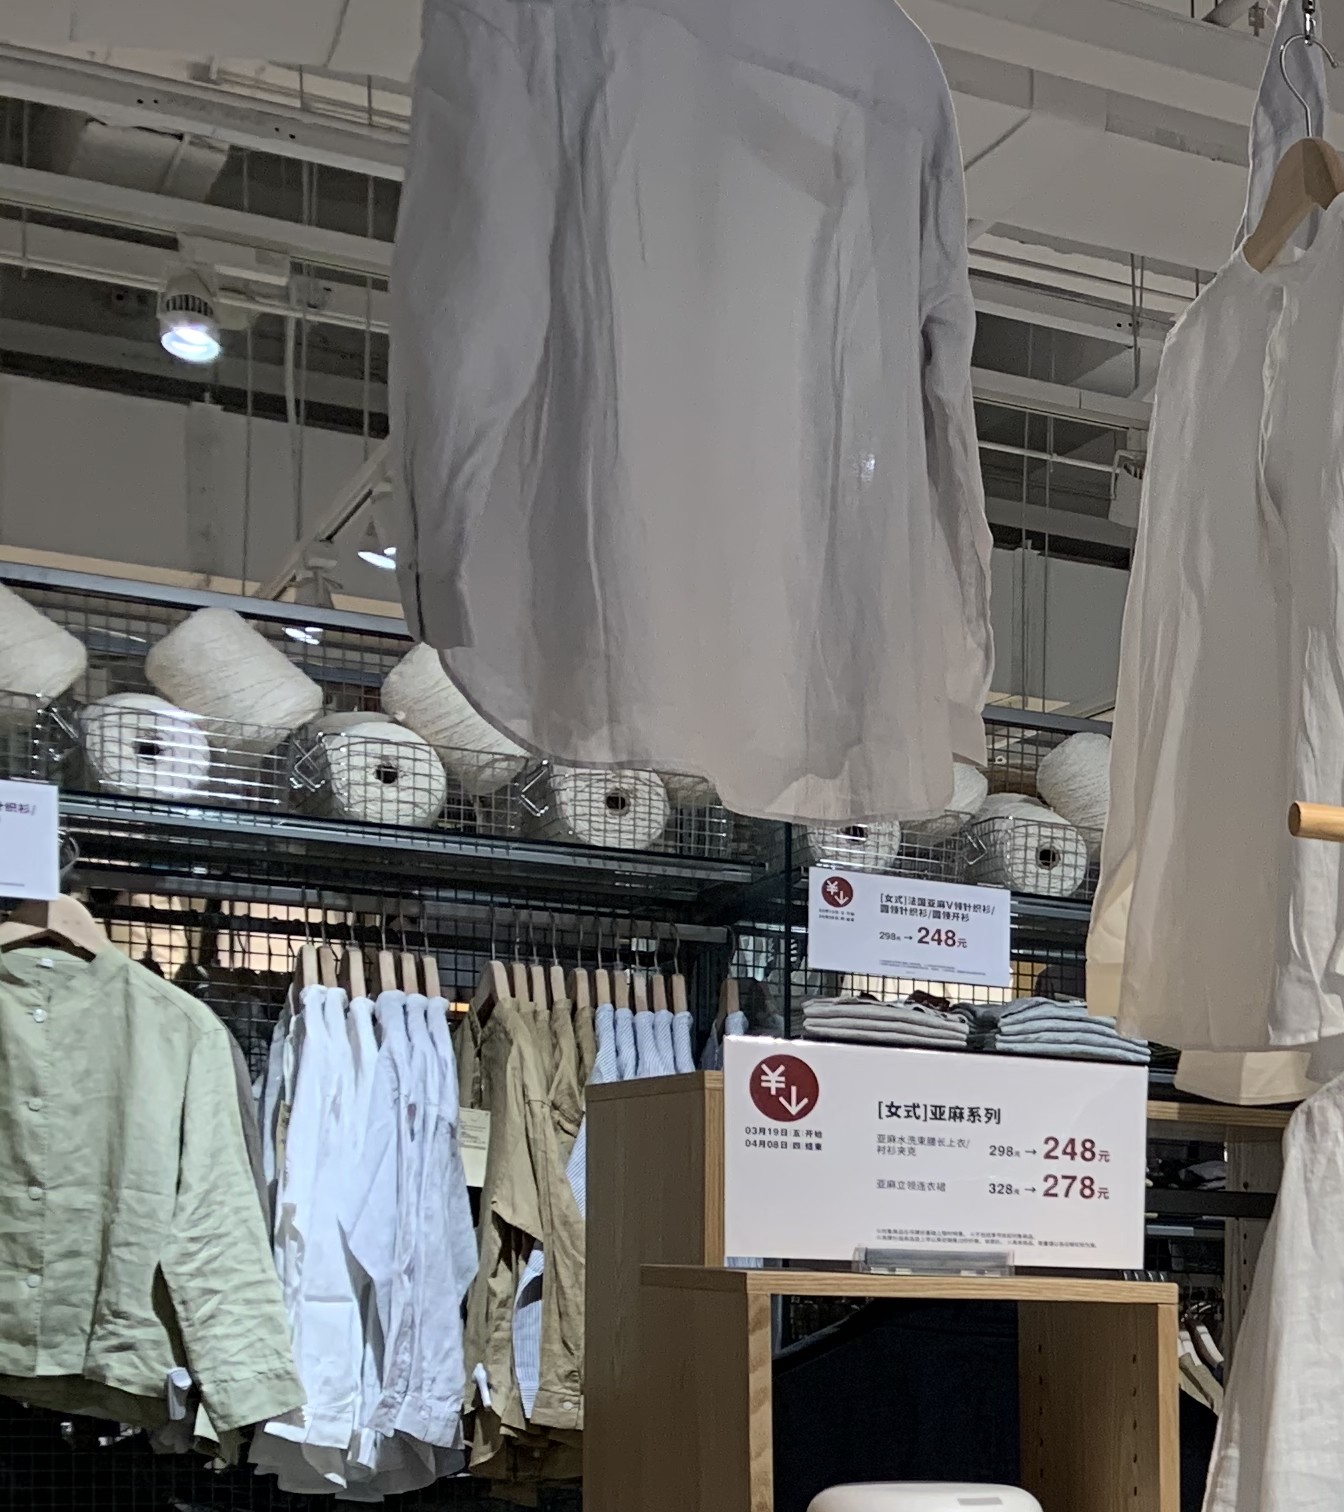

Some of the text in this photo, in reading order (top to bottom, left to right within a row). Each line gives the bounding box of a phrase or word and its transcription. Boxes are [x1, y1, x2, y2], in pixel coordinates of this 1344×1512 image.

[917, 926, 967, 949] 248元
[878, 1100, 1001, 1125] [女式]亚麻系列
[1043, 1136, 1110, 1163] 248元
[1043, 1174, 1110, 1200] 278元
